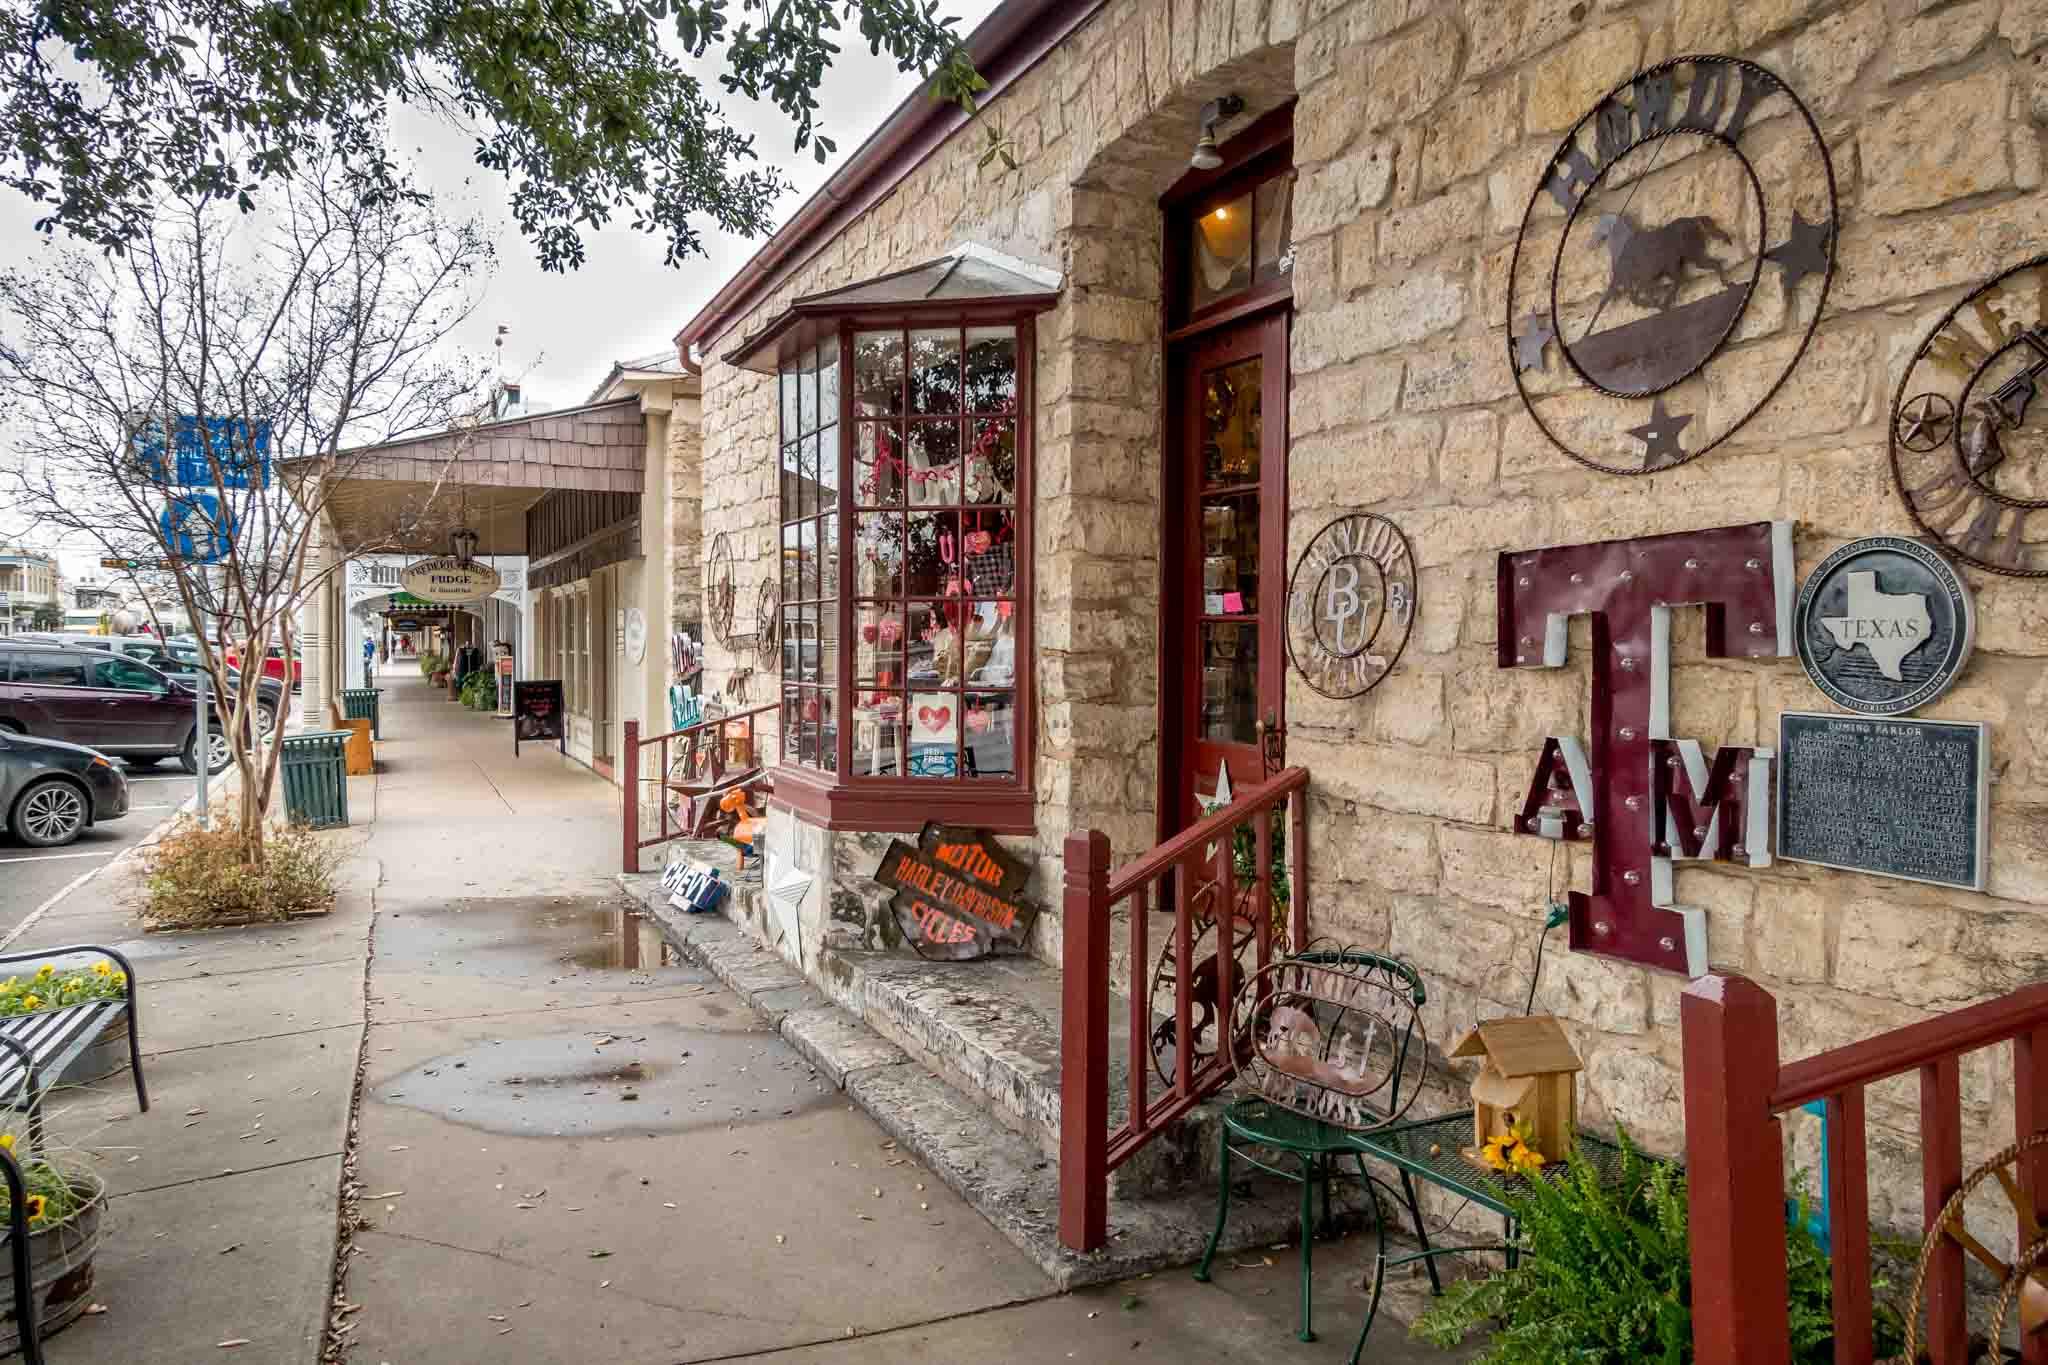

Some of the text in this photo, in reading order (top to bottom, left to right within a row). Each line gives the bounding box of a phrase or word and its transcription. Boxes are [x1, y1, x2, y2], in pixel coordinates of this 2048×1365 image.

[430, 574, 473, 584] FUDGE
[1827, 537, 1894, 567] HISTORICAL
[1904, 542, 1962, 602] COMMISSION
[1840, 619, 1921, 640] TEXAS
[1843, 696, 1897, 713] HISTORICAL
[1903, 670, 1949, 706] MEDALLION
[661, 861, 719, 906] CHEVY
[936, 843, 1004, 887] MOTOR
[911, 900, 977, 944] CYCLES
